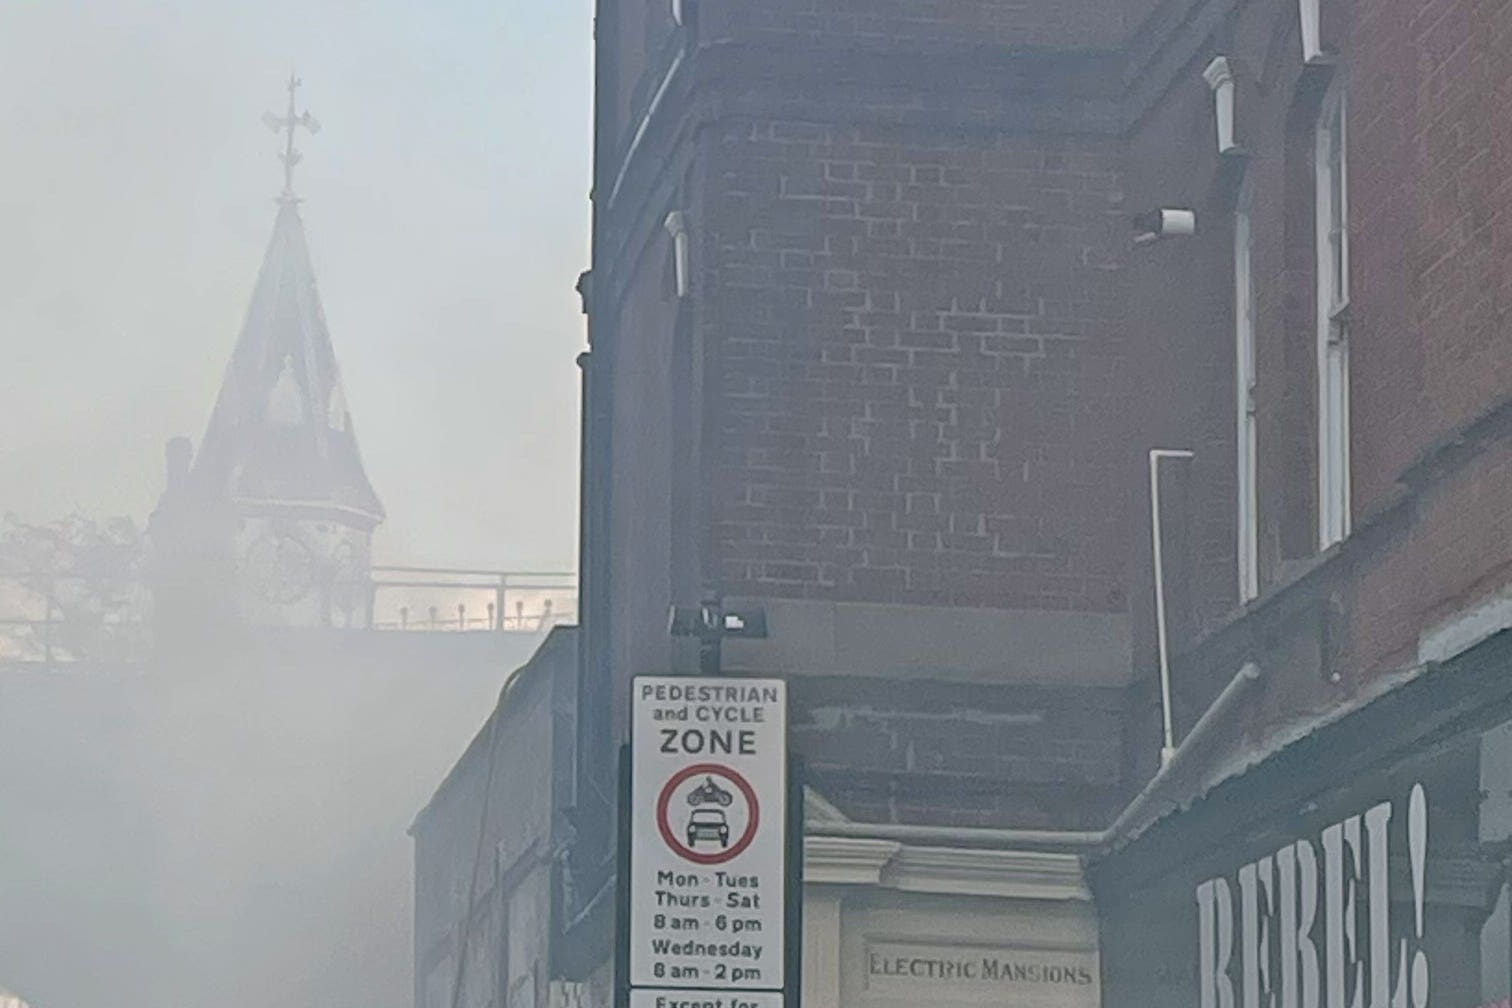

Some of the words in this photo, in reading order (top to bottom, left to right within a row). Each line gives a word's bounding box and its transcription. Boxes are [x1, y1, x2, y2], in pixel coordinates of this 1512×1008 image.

[641, 684, 778, 703] PEDESTRIAN
[653, 706, 688, 721] and
[695, 706, 764, 722] CYCLE
[659, 729, 757, 755] ZONE
[657, 870, 699, 887] Mon
[714, 871, 759, 888] Tues
[655, 890, 711, 908] Thurs
[726, 891, 760, 909] Sat
[653, 914, 666, 930] 8
[670, 918, 699, 930] am
[714, 914, 727, 931] 6
[732, 919, 762, 933] pm
[652, 939, 763, 961] Wednesday
[653, 962, 665, 978] 8
[670, 966, 699, 979] am
[714, 963, 726, 980] 2
[731, 967, 761, 982] pm
[869, 952, 976, 979] ELECTRIC
[981, 958, 1093, 986] MANSIONS
